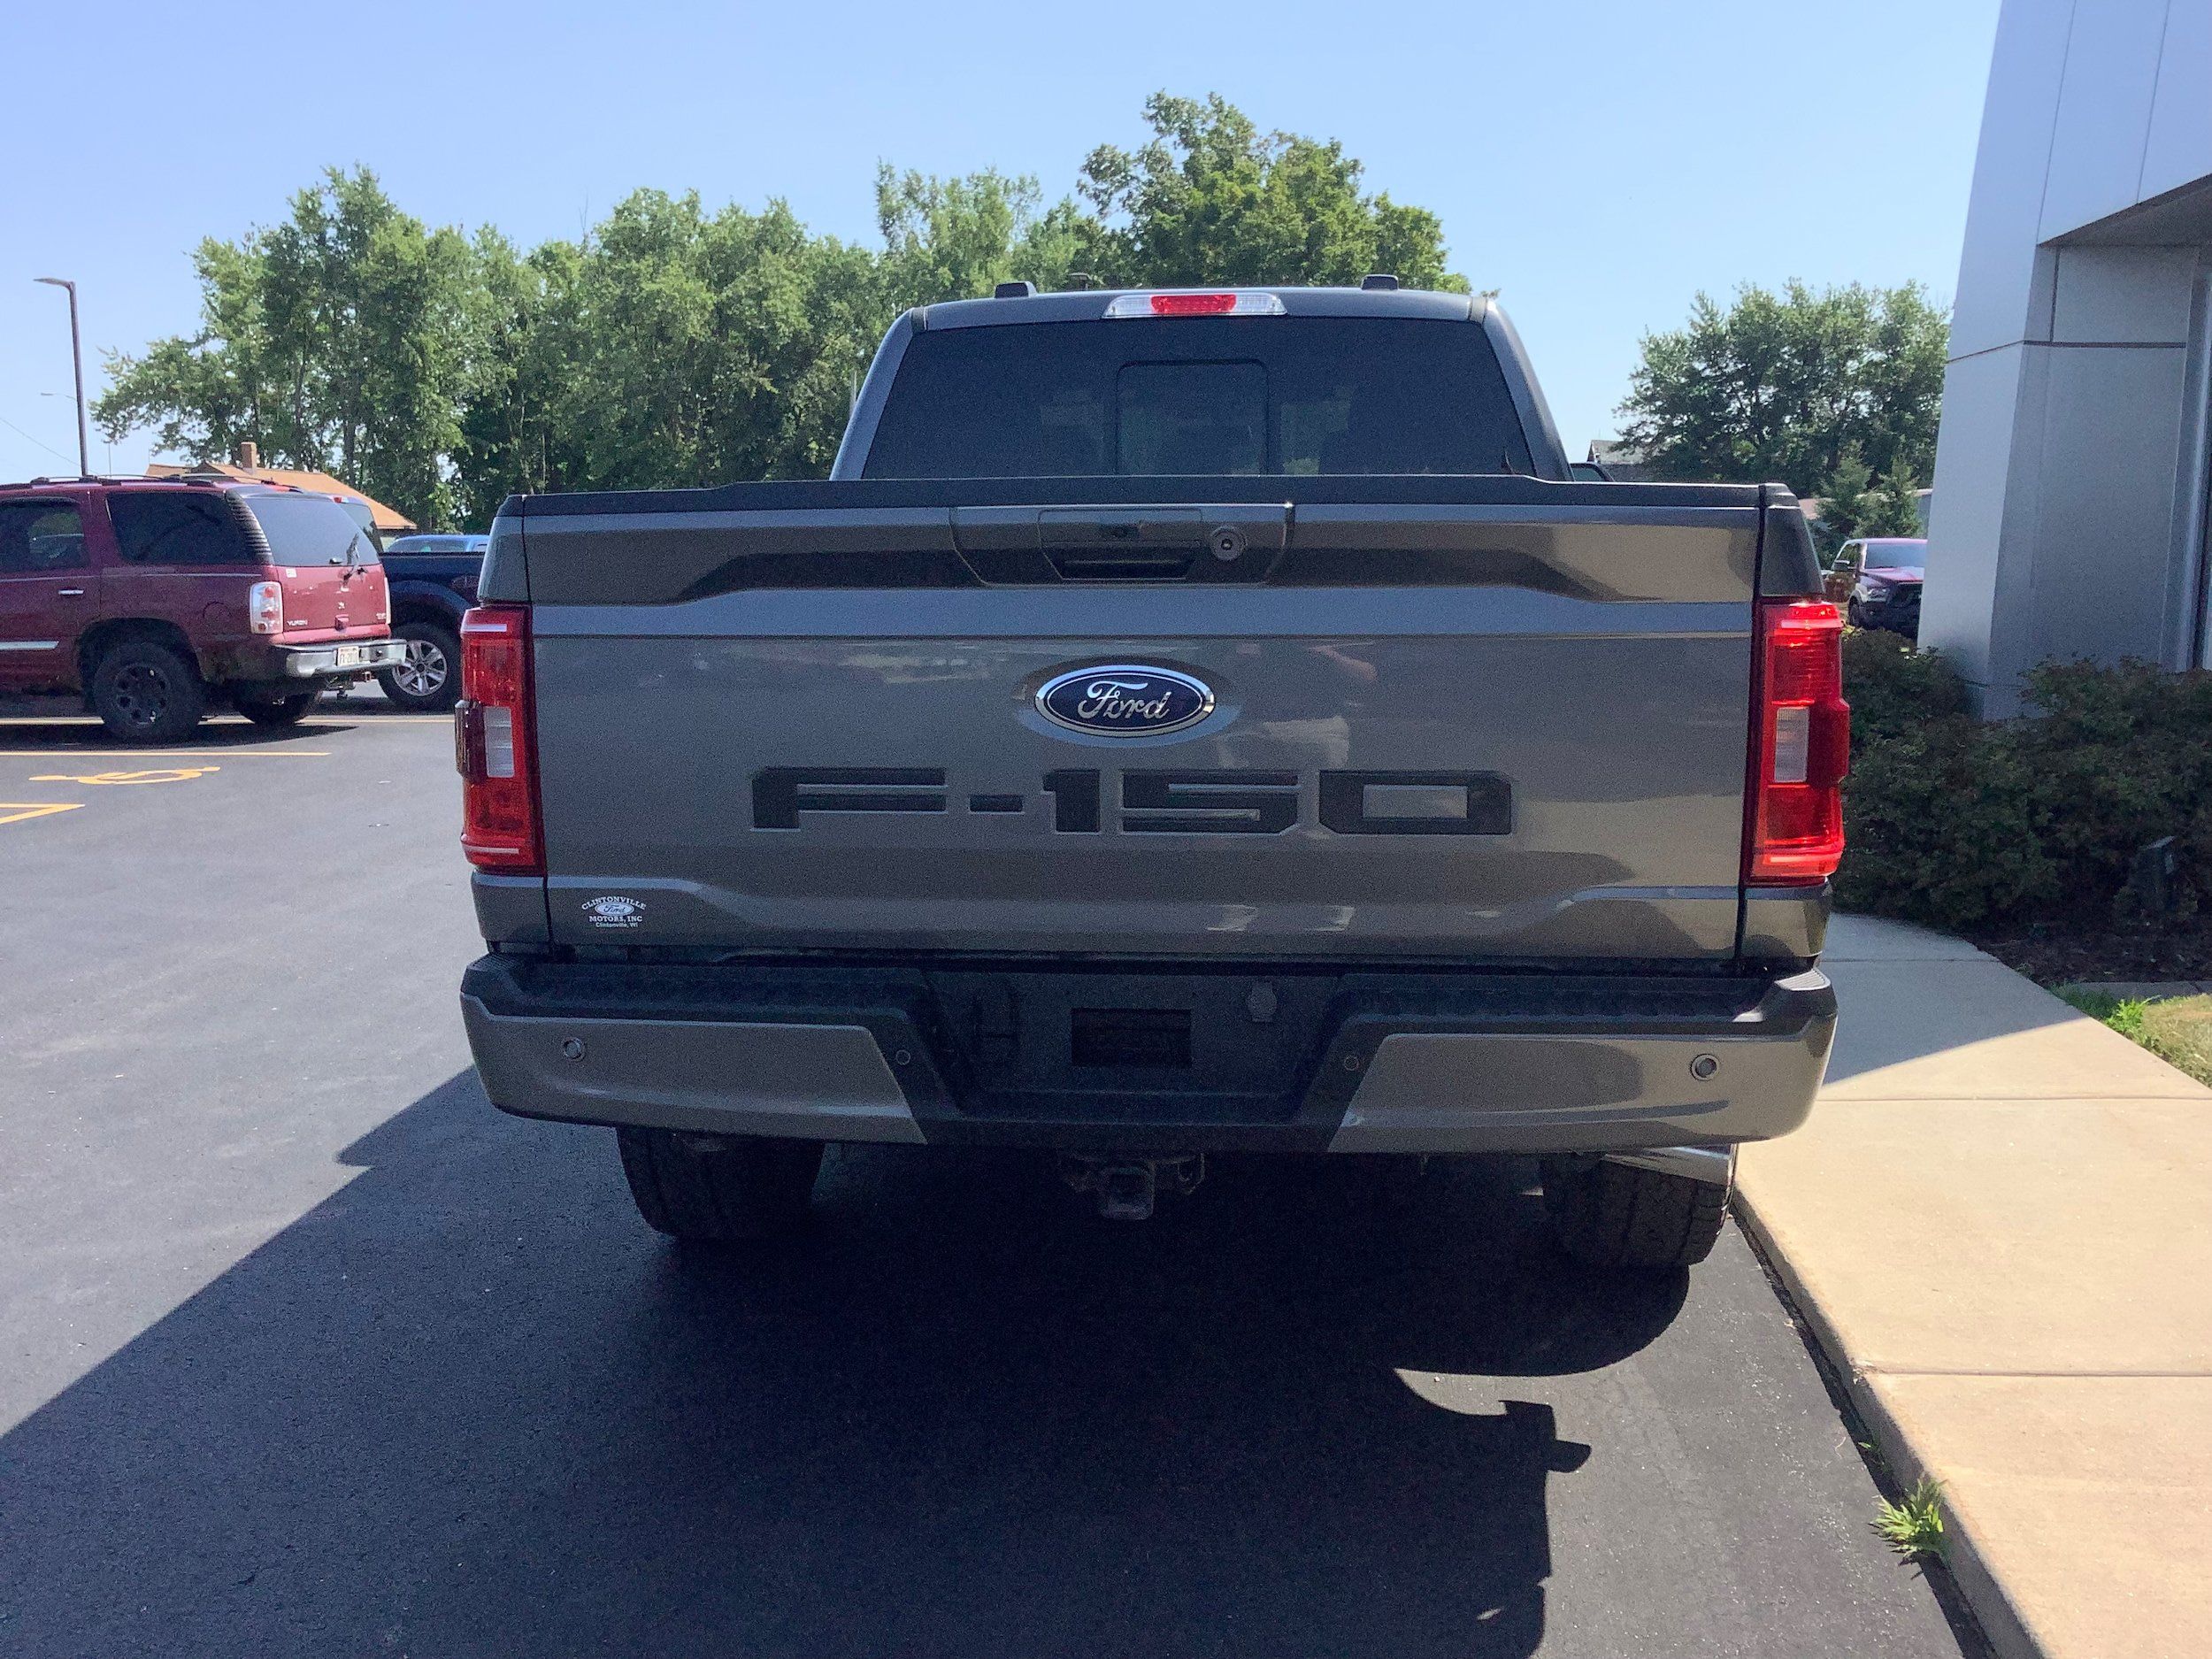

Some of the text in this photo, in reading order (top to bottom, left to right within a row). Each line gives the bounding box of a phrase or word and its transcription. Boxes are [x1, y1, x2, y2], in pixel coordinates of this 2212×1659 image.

[1078, 680, 1172, 719] Ford
[751, 767, 1512, 834] F-150
[581, 896, 647, 910] CLINTONVILLE
